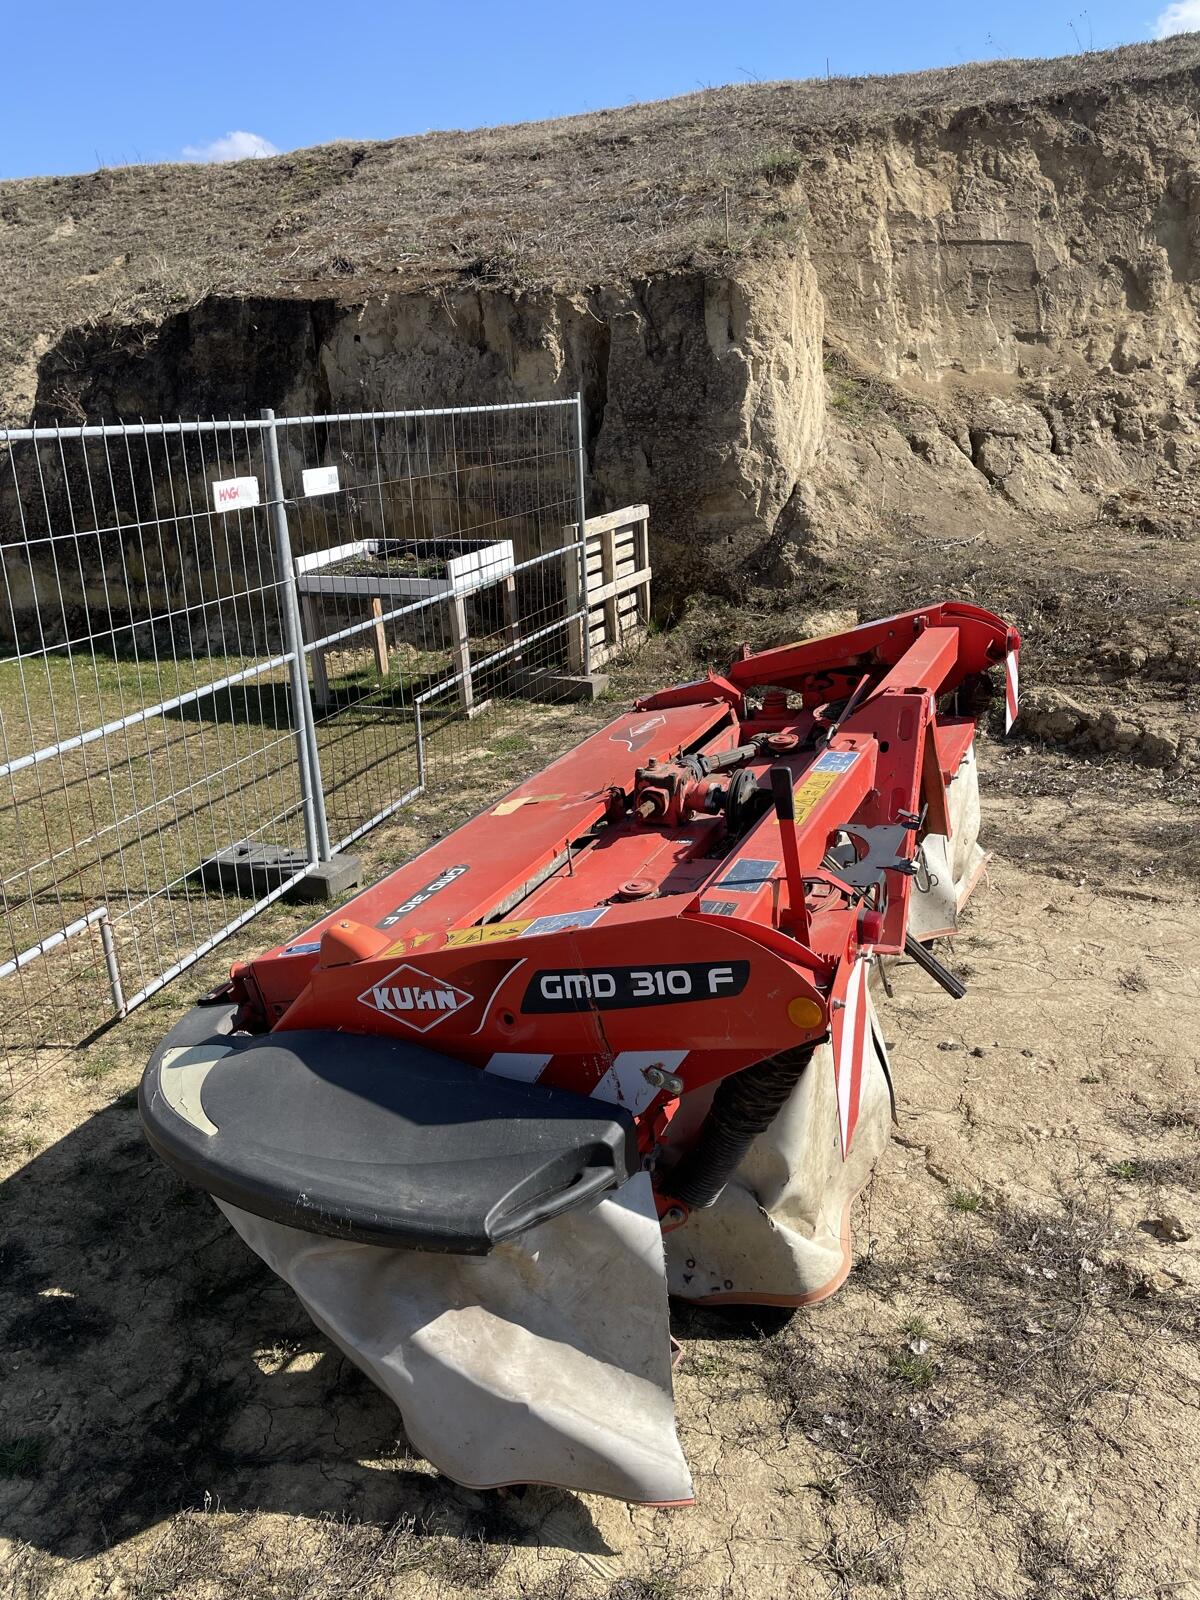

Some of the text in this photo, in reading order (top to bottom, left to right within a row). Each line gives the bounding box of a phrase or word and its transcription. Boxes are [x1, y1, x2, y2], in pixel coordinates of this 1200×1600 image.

[383, 868, 466, 925] GMD 310 F
[372, 986, 457, 1010] KUHN
[540, 967, 734, 999] GMD 310 F
